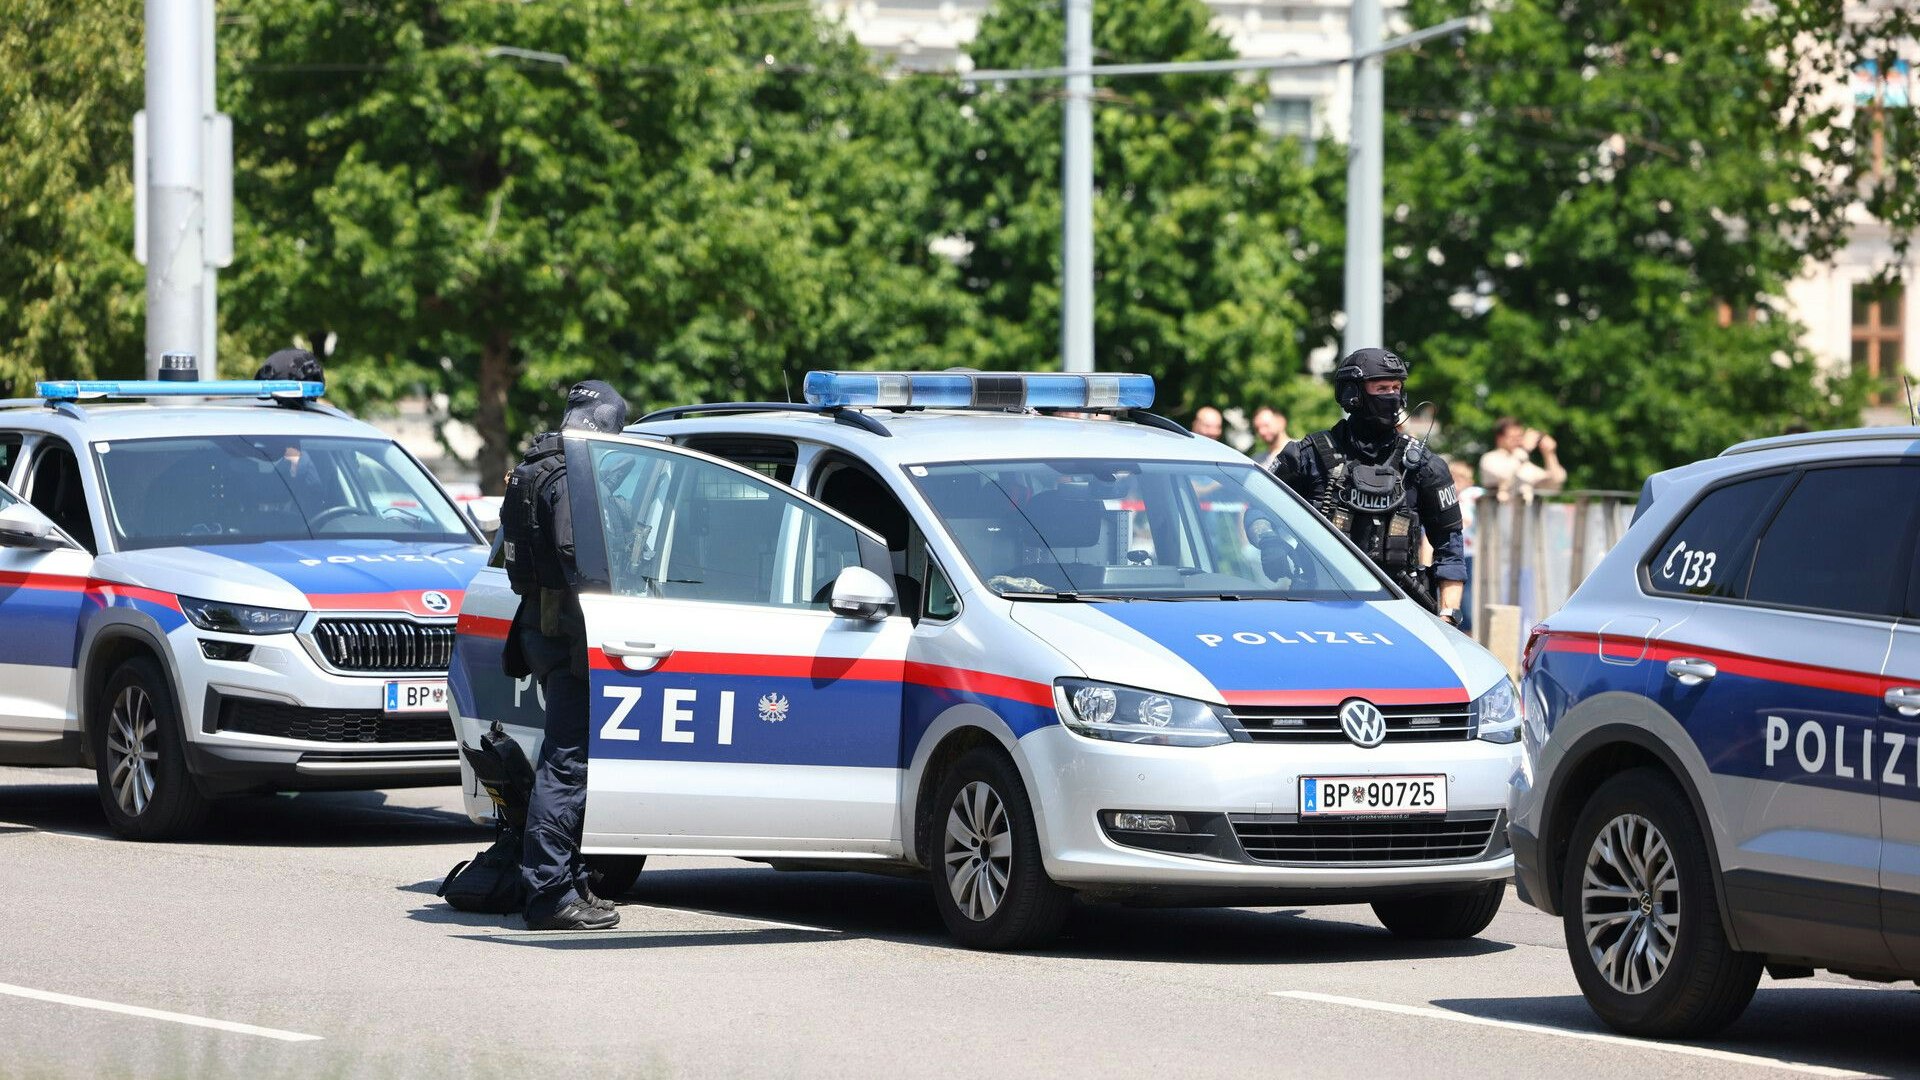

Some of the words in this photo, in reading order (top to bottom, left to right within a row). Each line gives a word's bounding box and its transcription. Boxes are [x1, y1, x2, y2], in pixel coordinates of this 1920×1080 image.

[1351, 488, 1390, 508] POLIZEI
[299, 554, 465, 567] POLIZEI
[1679, 550, 1716, 588] 133
[1196, 631, 1394, 647] POLIZEI
[407, 686, 430, 707] BP
[600, 685, 735, 745] ZEI
[1765, 715, 1920, 788] POLIZ
[1307, 799, 1314, 808] A
[1323, 783, 1350, 808] BP
[1367, 781, 1435, 807] 90725
